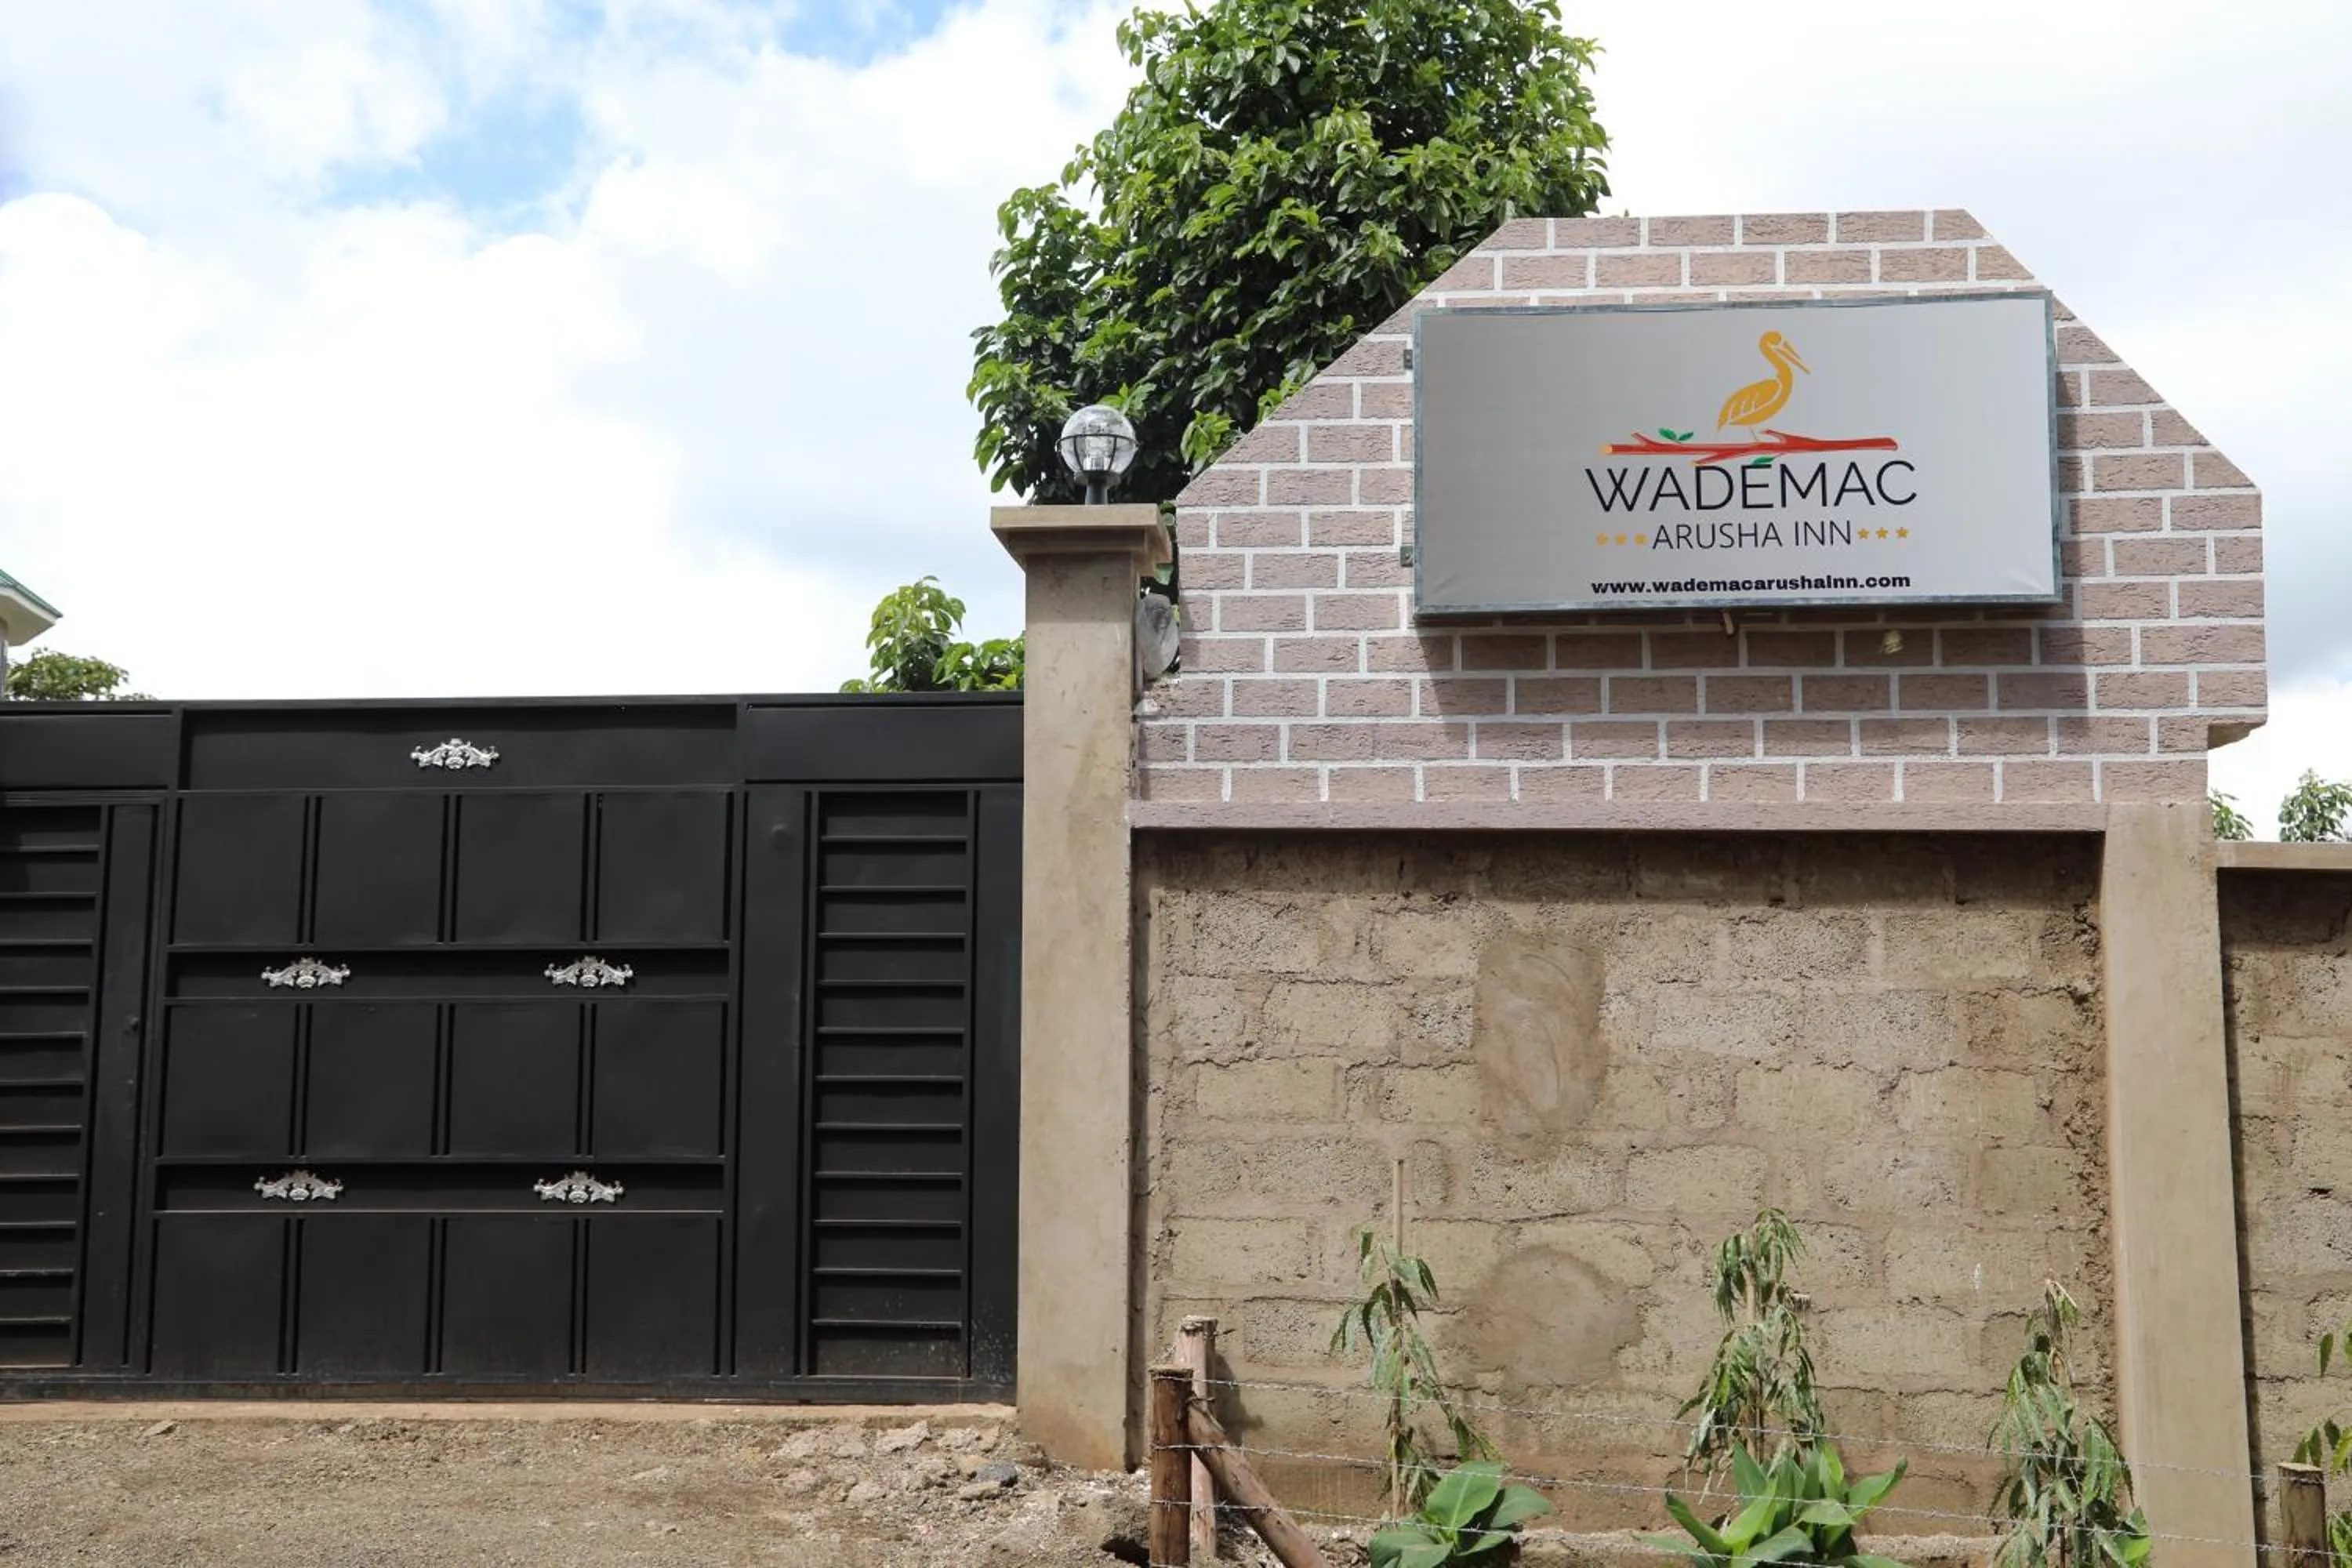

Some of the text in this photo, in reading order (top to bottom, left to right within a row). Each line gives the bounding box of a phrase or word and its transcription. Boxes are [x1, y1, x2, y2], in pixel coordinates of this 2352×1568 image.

[1584, 460, 1918, 512] WADEMAC
[1652, 520, 1852, 550] ARUSHA INN
